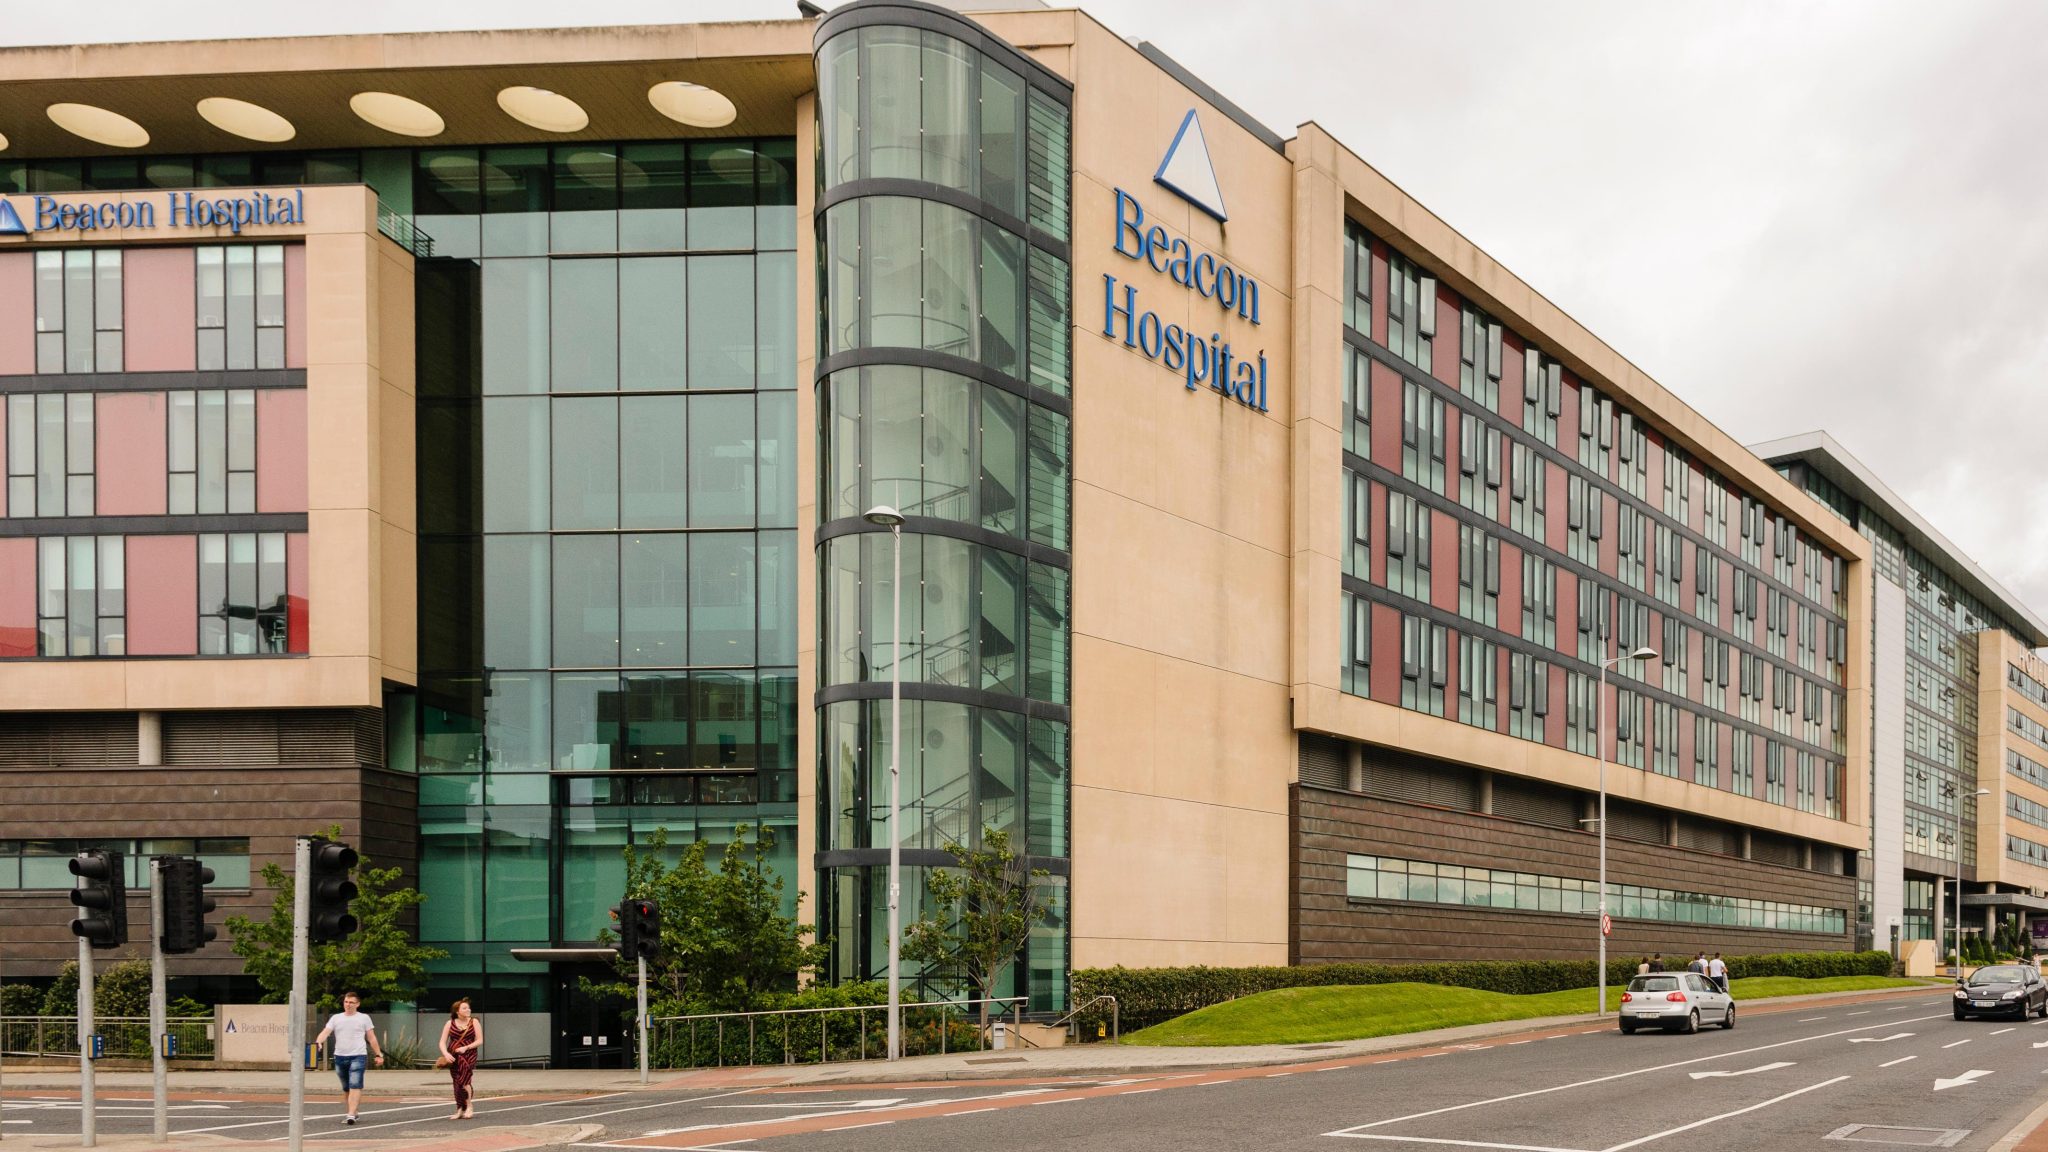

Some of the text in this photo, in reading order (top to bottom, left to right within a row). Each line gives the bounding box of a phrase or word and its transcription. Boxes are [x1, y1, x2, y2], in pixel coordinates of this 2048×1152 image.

[33, 189, 305, 234] Beacon Hospital
[1112, 186, 1262, 326] Beacon
[1102, 273, 1270, 413] Hospital
[241, 1022, 289, 1037] Beacon Hospi
